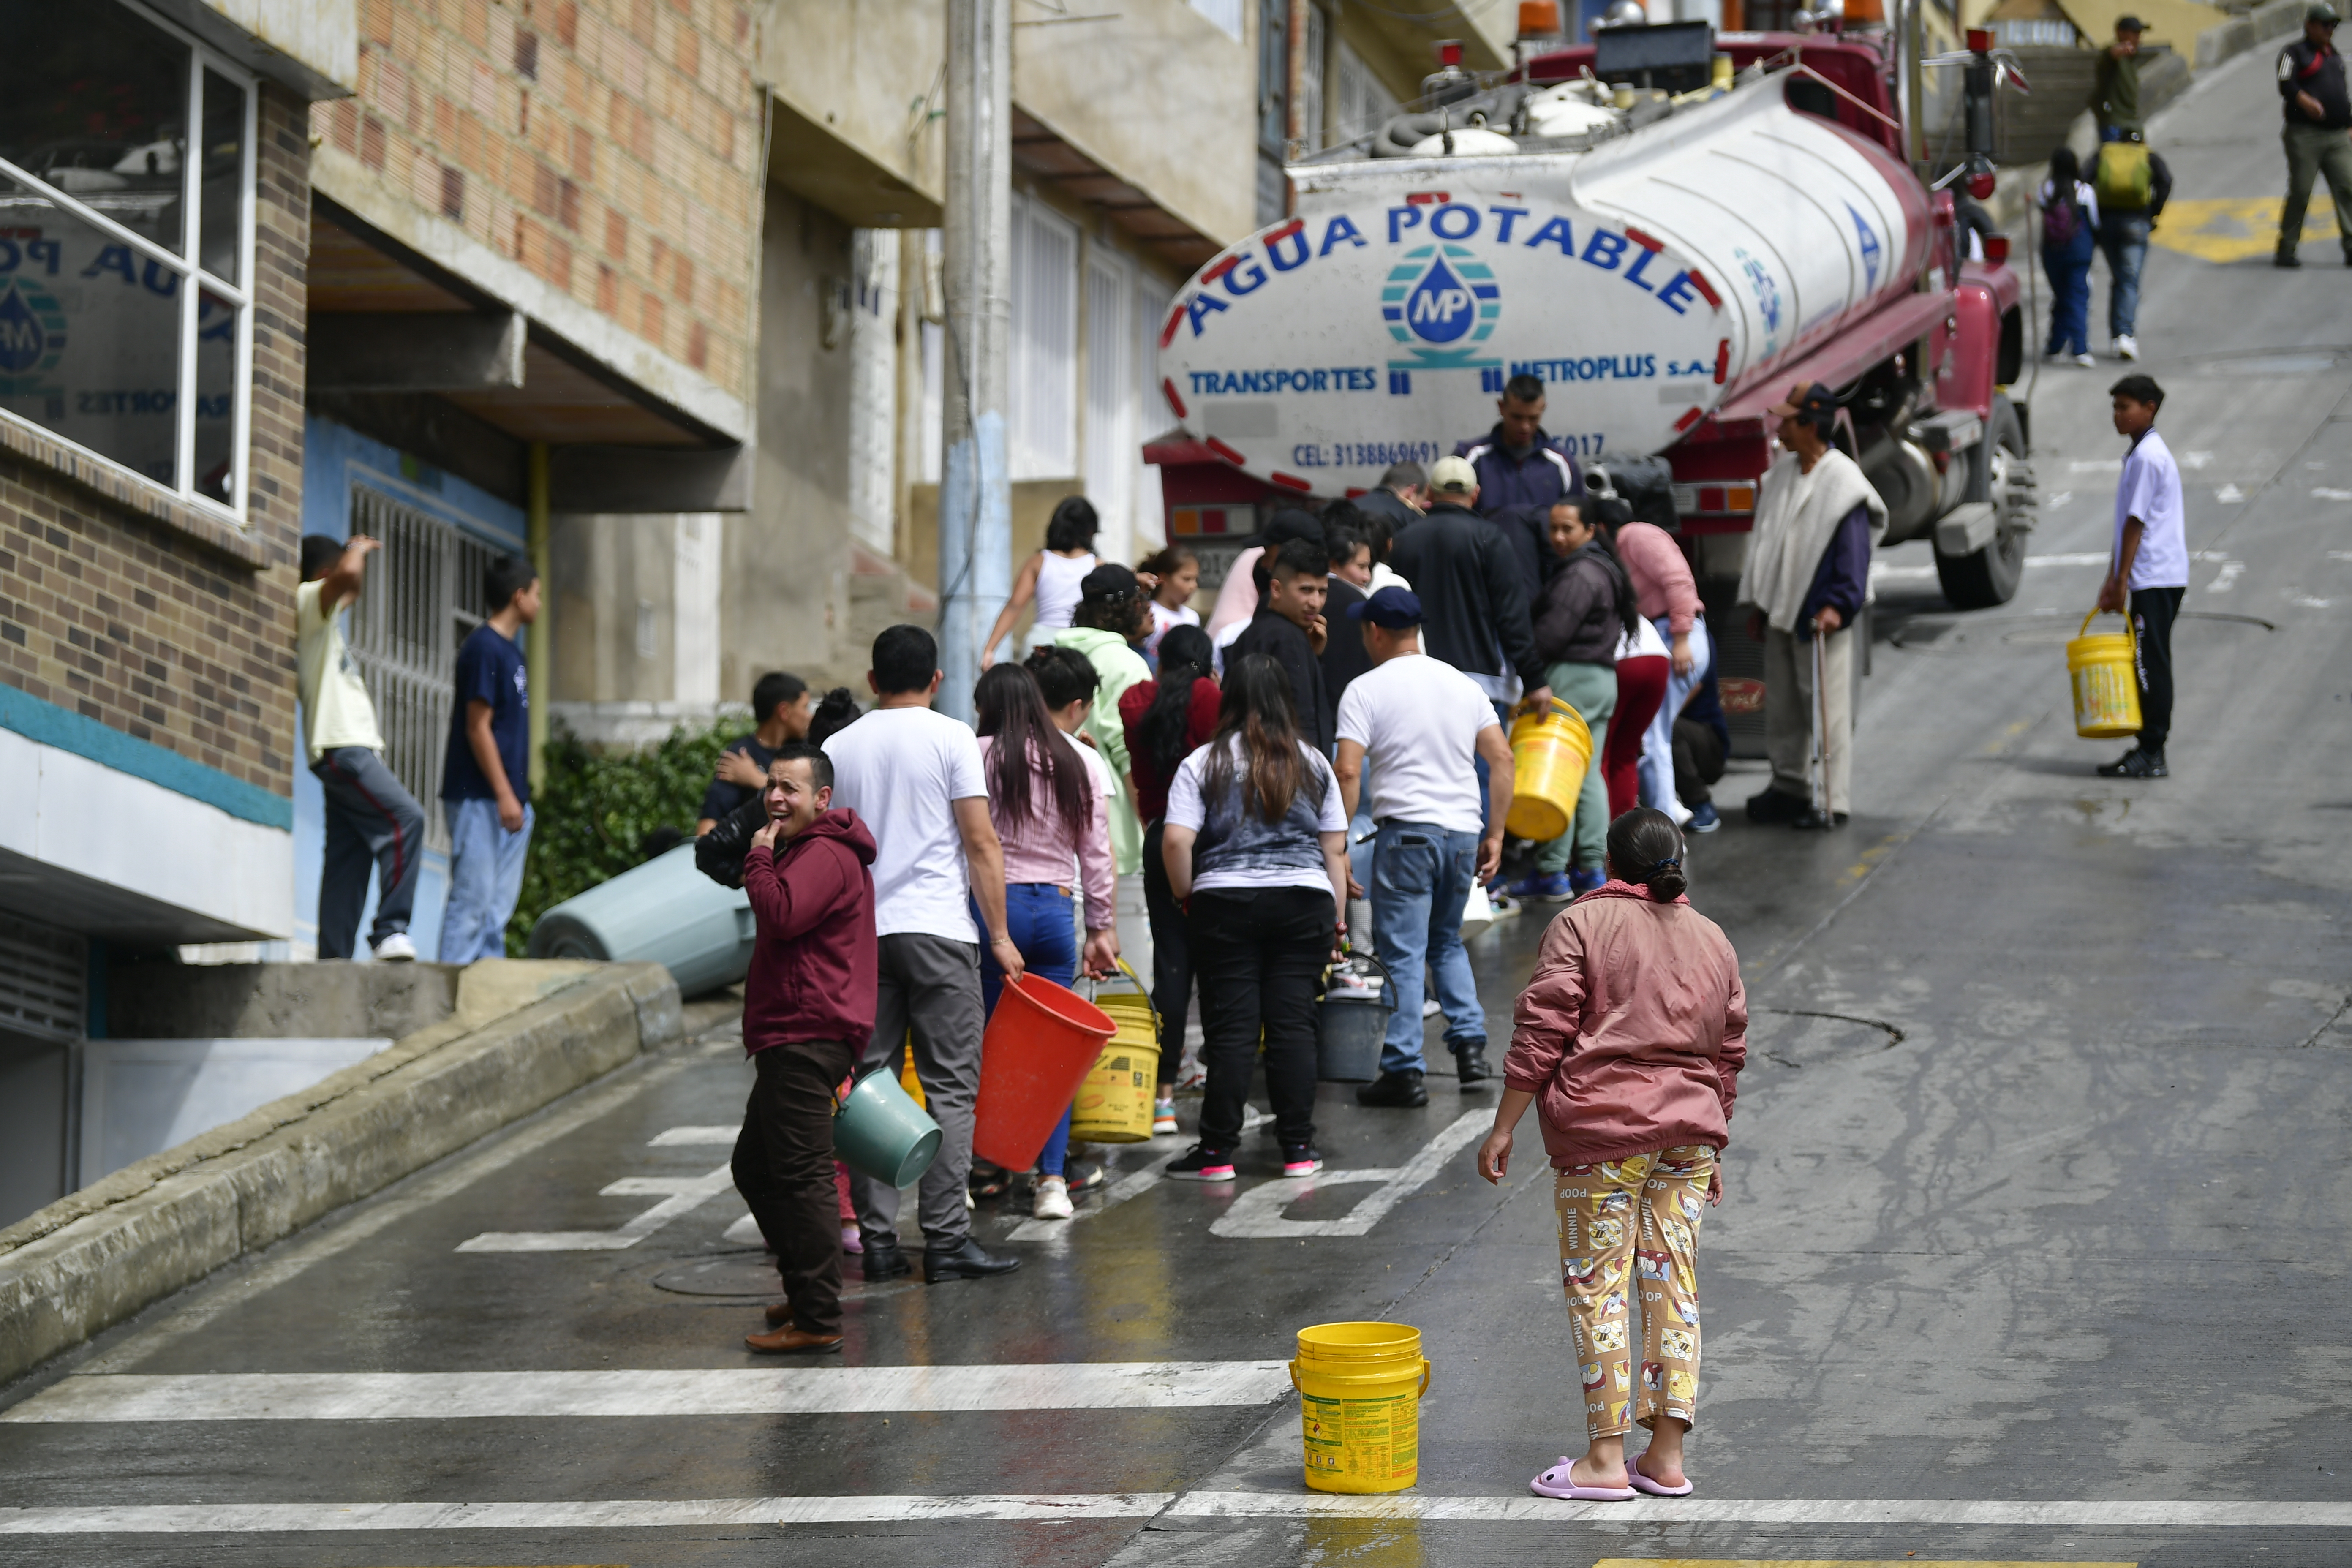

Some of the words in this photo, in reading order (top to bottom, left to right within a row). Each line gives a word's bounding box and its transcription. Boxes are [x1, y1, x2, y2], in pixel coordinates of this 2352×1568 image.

[1185, 214, 1368, 337] AGUA
[1388, 203, 1702, 315] POTABLE
[1413, 289, 1469, 324] MP
[1188, 366, 1376, 395] TRANSPORTES
[1510, 354, 1656, 381] METROPLUS
[1294, 442, 1329, 466] CEL:
[1567, 1207, 1579, 1250] WINNIE
[1641, 1195, 1653, 1241] WINNIE
[1573, 1314, 1585, 1358] WINNIE
